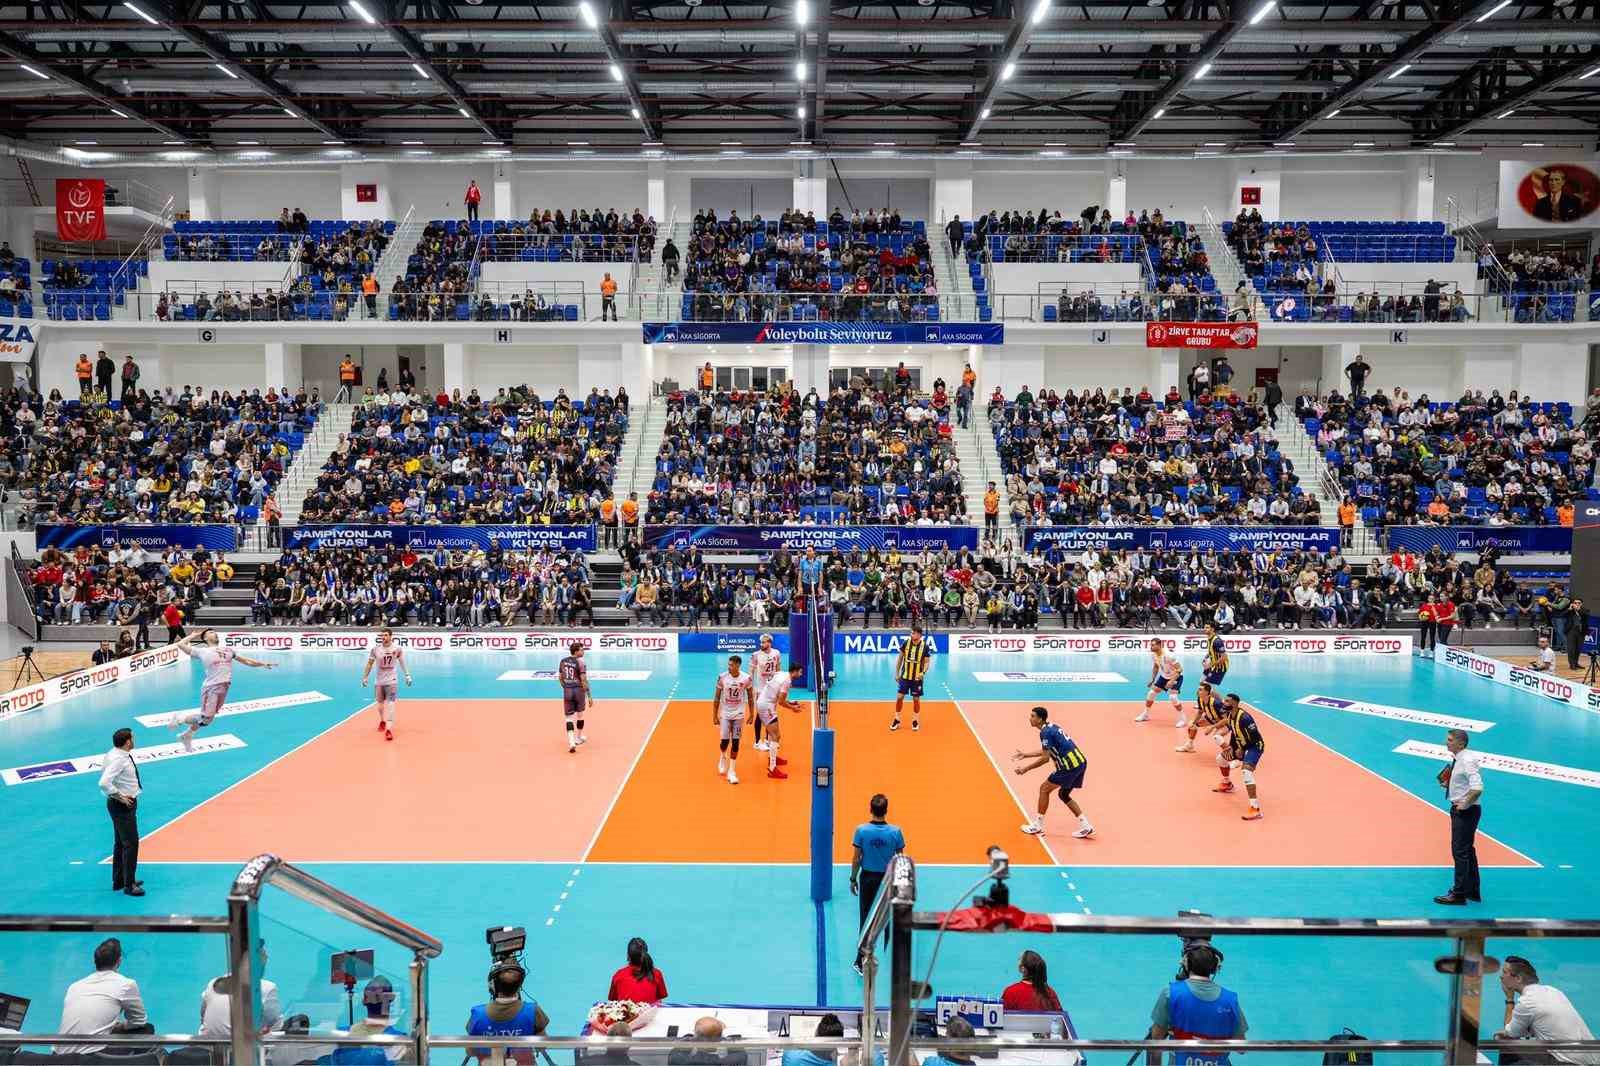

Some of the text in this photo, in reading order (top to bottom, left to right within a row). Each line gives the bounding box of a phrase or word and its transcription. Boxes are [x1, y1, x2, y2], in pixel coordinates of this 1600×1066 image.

[64, 210, 96, 225] TVF
[202, 330, 212, 342] G
[498, 330, 508, 342] H
[764, 328, 892, 342] Voleybolu Seviyoruz
[1097, 332, 1106, 343] J
[1393, 331, 1403, 343] K
[692, 538, 707, 546] AXA
[902, 539, 916, 547] AXA
[845, 635, 938, 652] MALAA
[1108, 639, 1176, 649] SPORTTO
[1184, 639, 1251, 649] SPOOTO
[0, 688, 45, 714] RTOTO
[989, 1010, 998, 1025] 0
